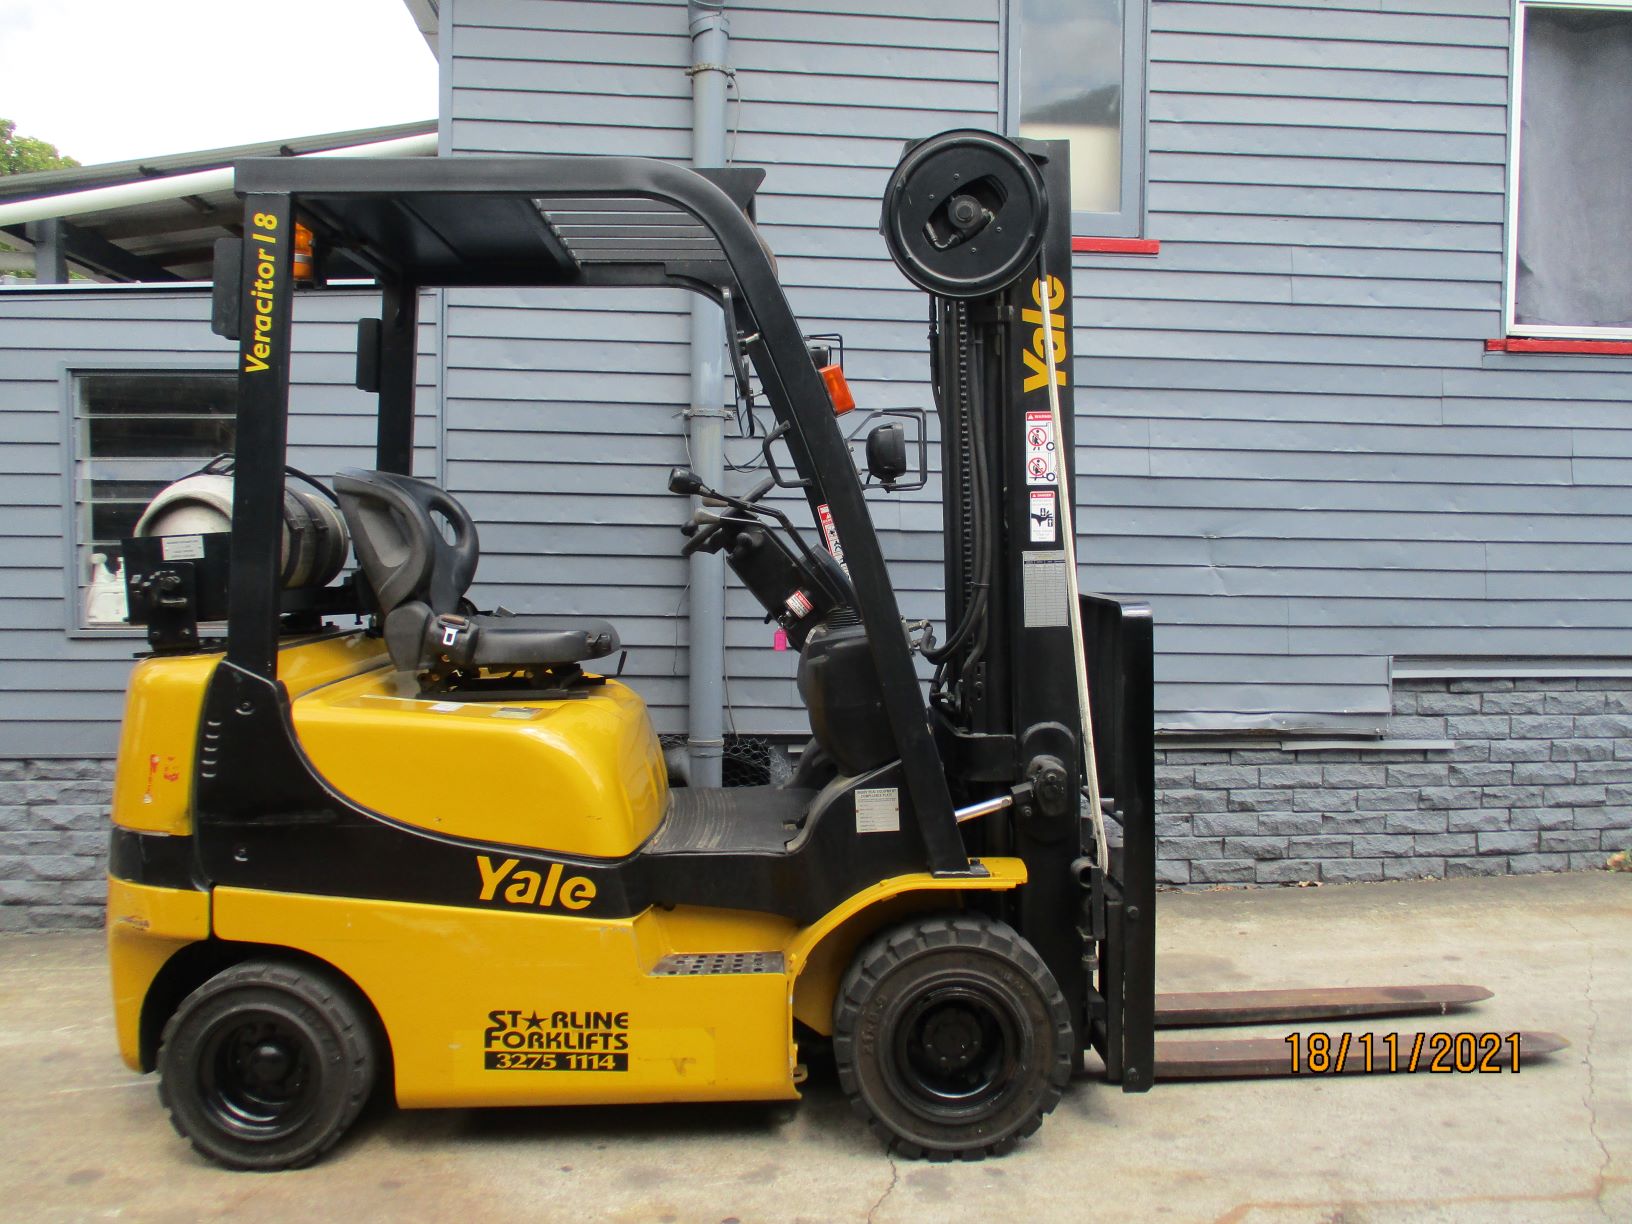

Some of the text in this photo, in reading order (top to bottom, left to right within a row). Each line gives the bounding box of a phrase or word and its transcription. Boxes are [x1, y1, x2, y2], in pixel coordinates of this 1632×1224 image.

[245, 248, 275, 373] Veracitor
[1021, 274, 1066, 393] Yale
[476, 855, 597, 910] Yale
[484, 1027, 628, 1050] FORKLIFTS
[496, 1054, 616, 1070] 3275 1114
